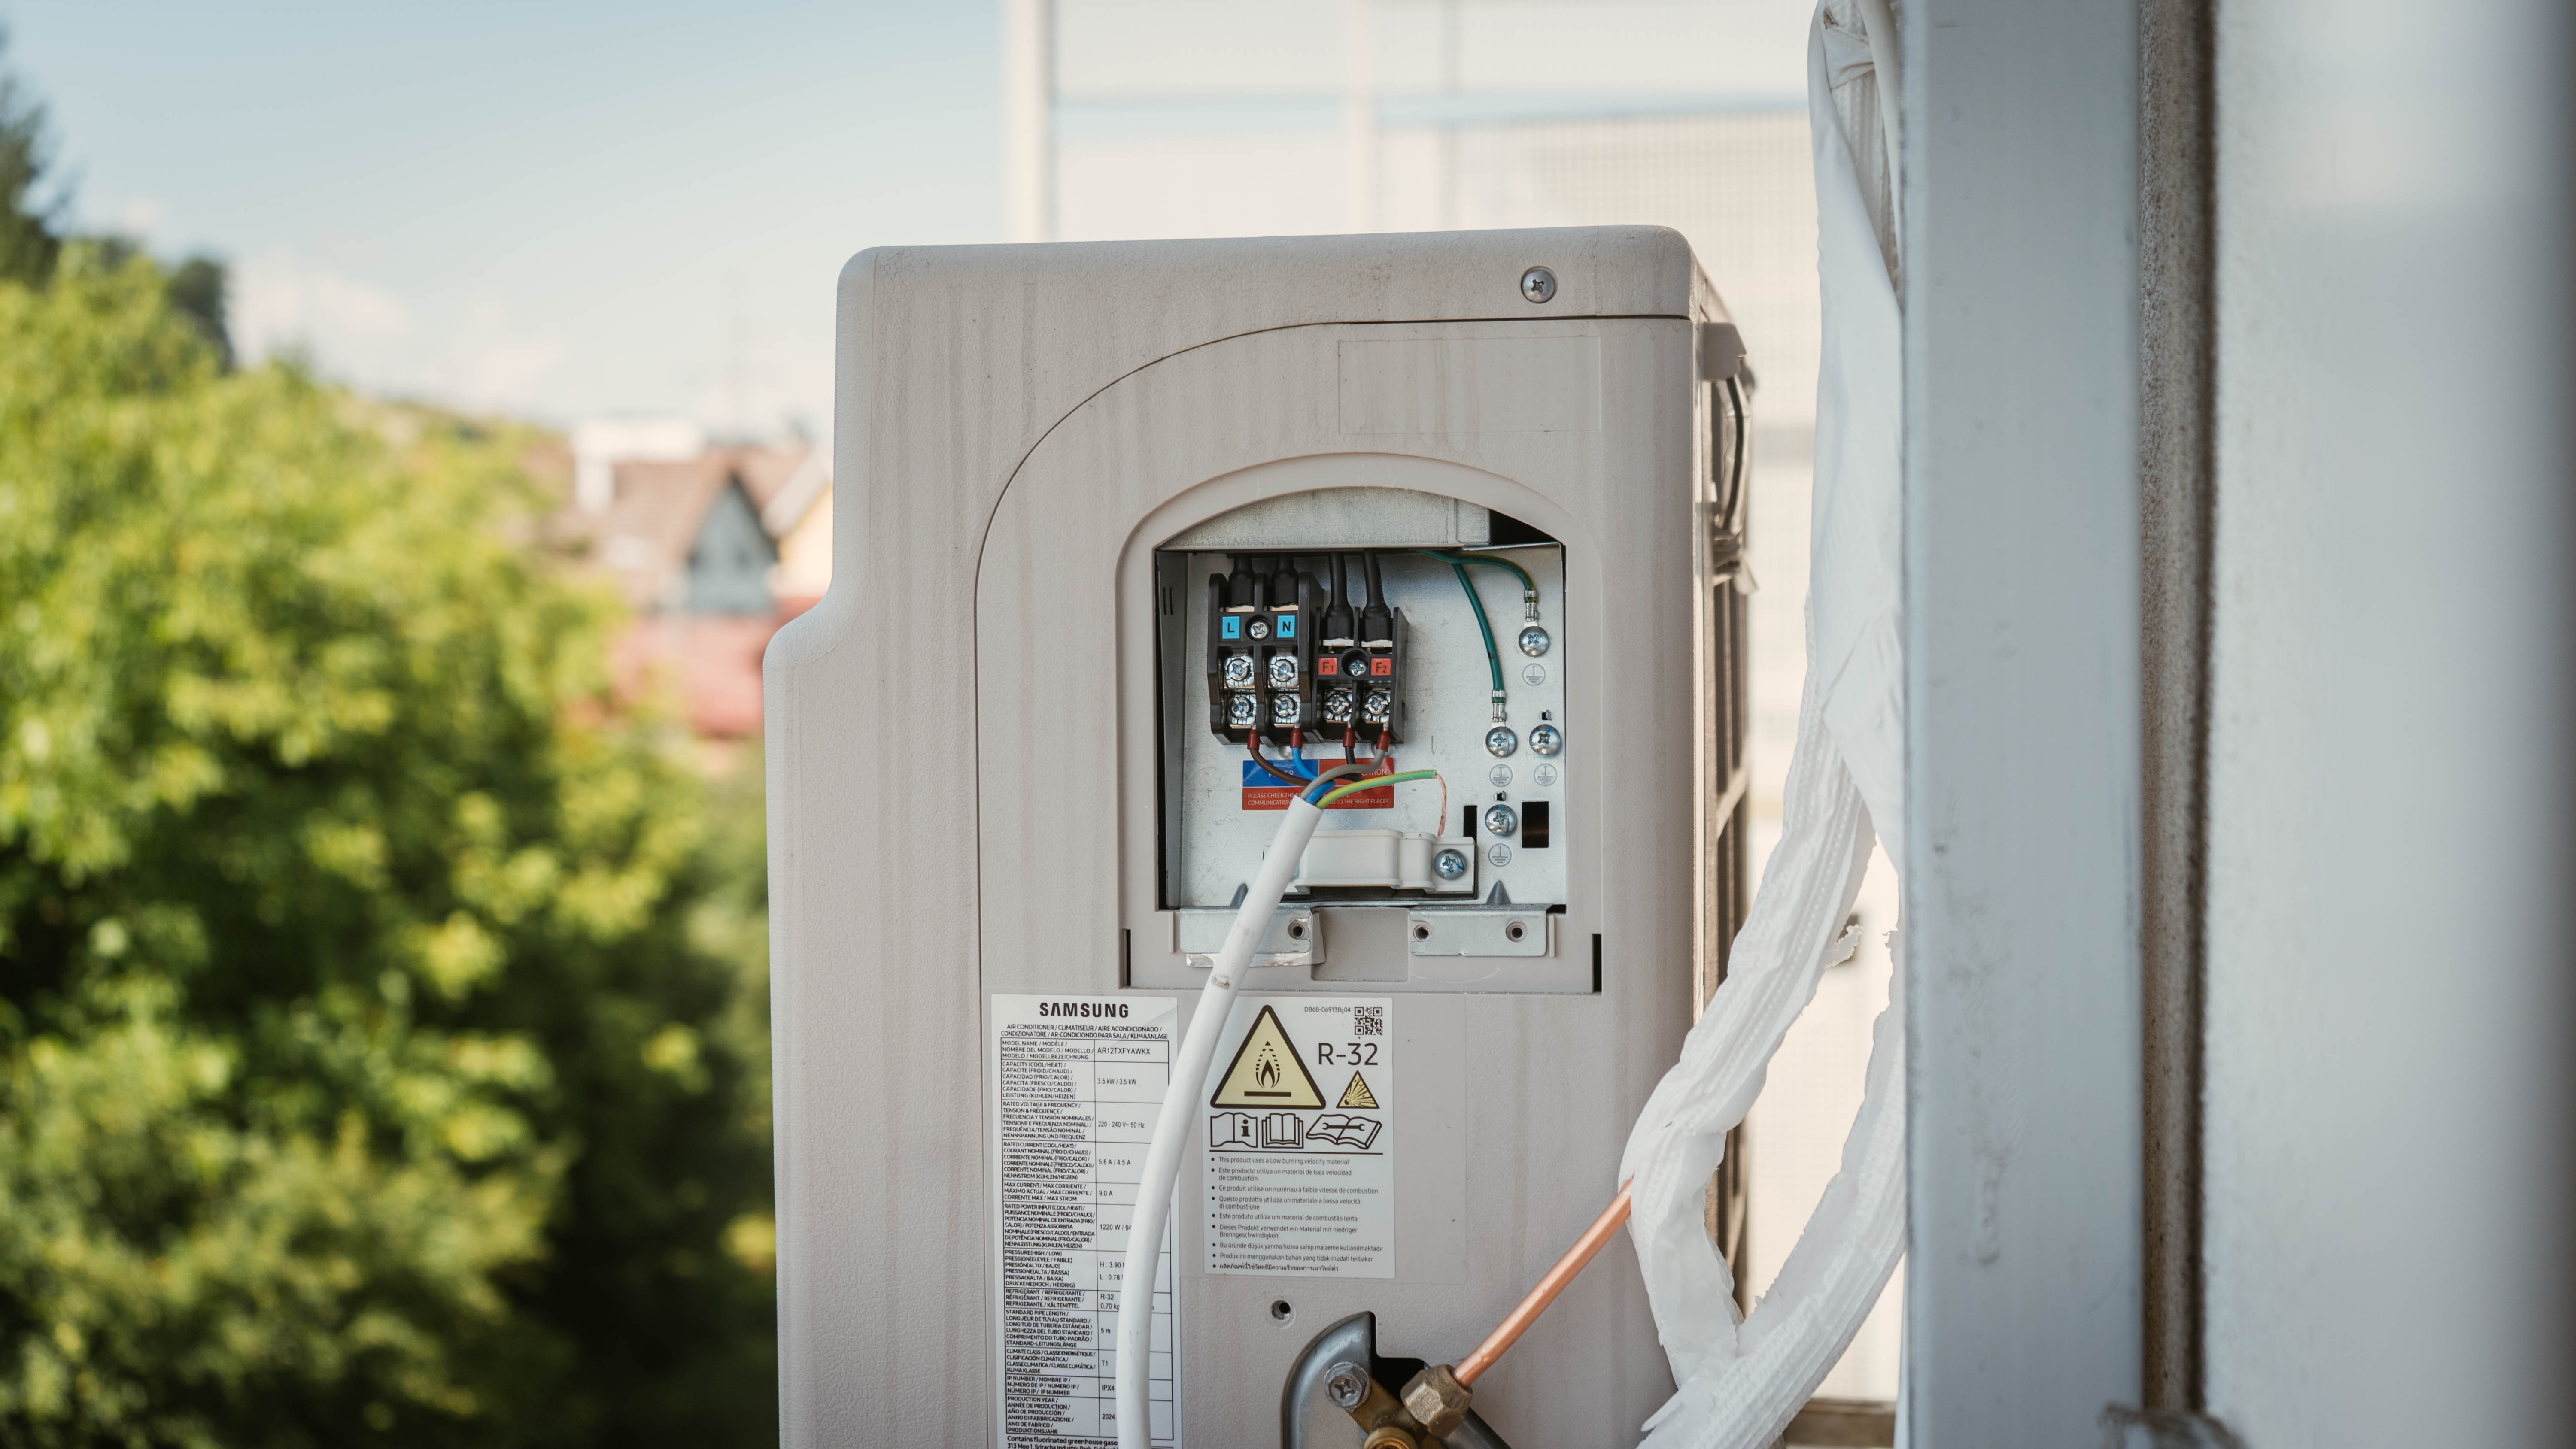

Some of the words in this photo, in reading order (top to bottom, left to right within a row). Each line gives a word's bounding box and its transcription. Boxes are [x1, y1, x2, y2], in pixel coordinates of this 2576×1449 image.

[1227, 622, 1235, 633] L
[1282, 621, 1291, 631] N
[1323, 661, 1334, 672] F1
[1376, 662, 1387, 673] F2
[1039, 1002, 1128, 1018] SAMSUNG
[1097, 1046, 1150, 1055] AR12TXFYAWKX
[1318, 1043, 1378, 1065] R-32
[1219, 1231, 1278, 1240] Brenngeschwindigkeit
[1067, 1438, 1103, 1446] greenhouse
